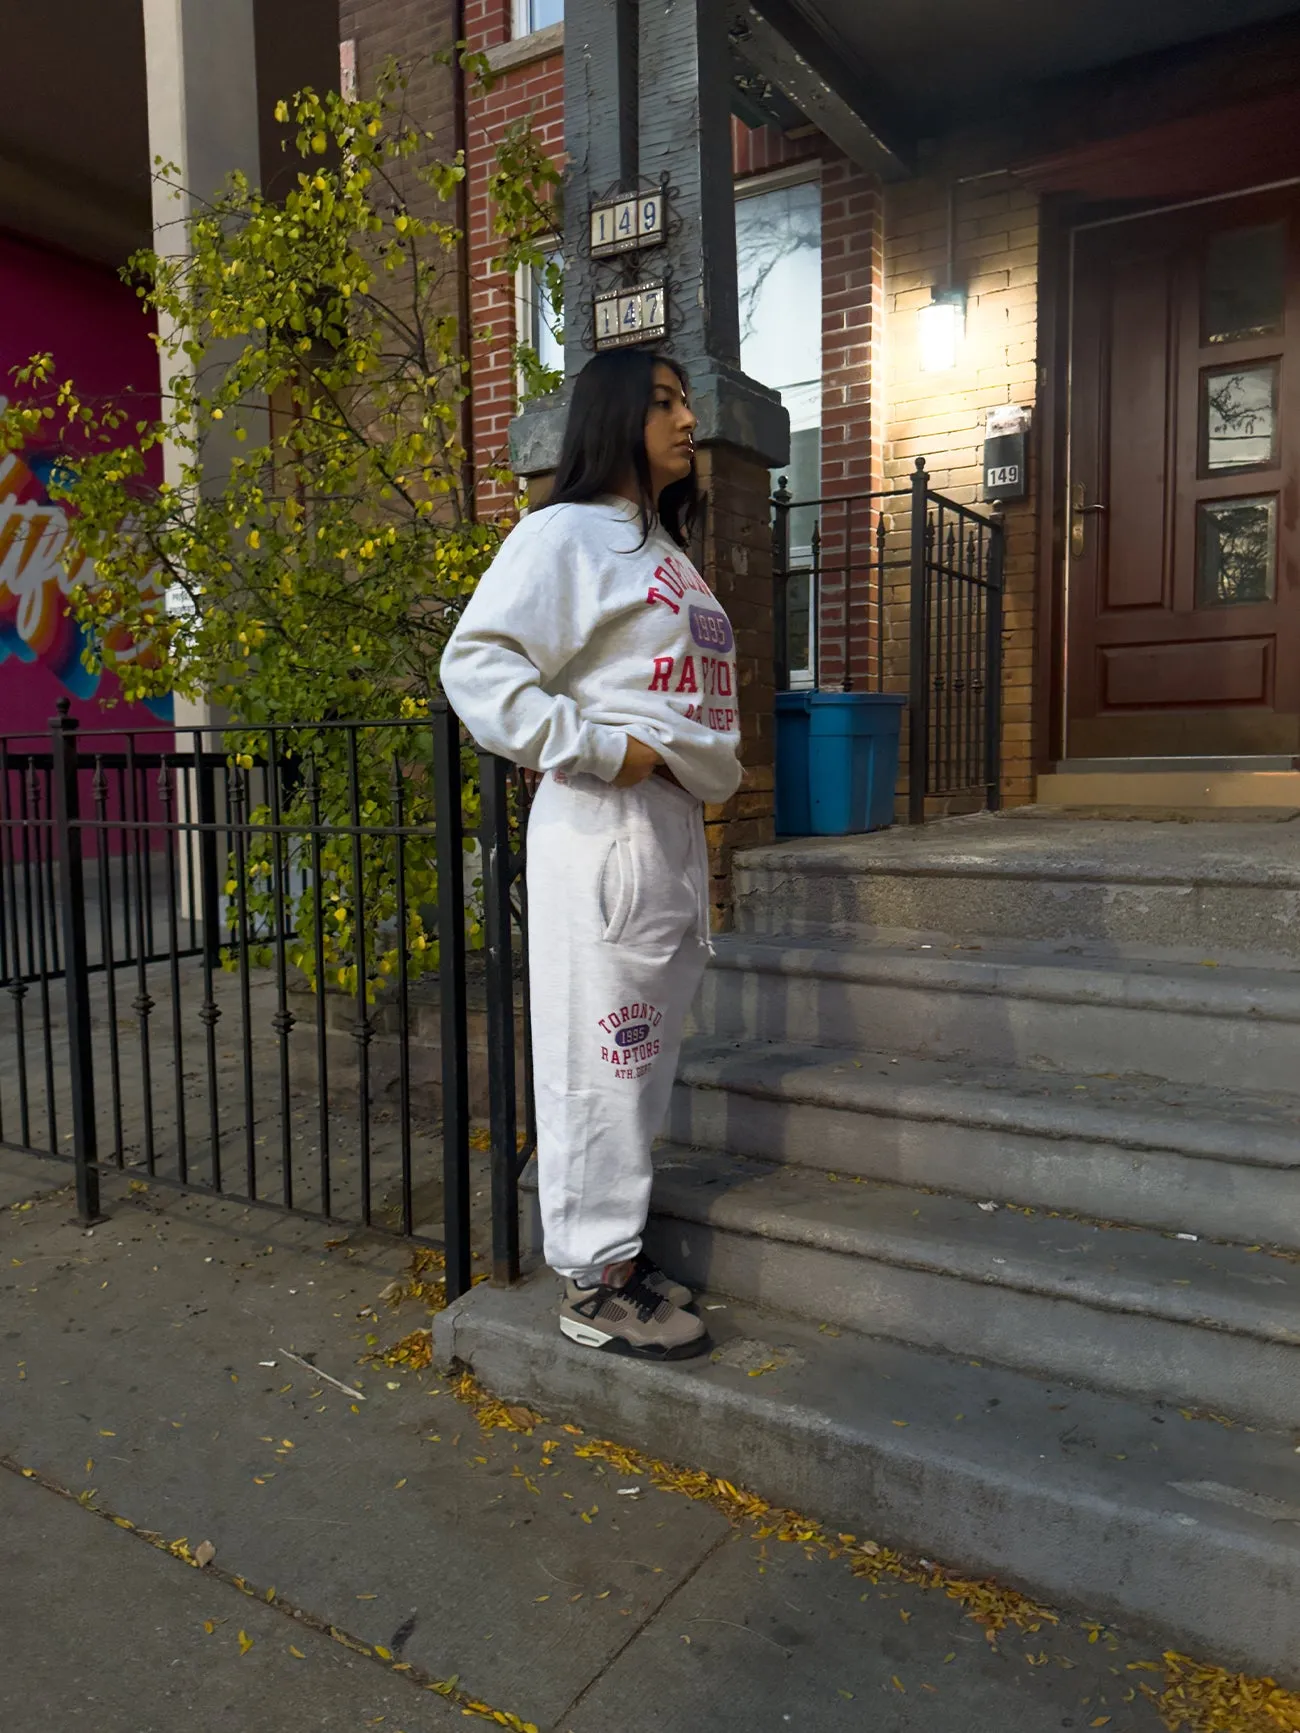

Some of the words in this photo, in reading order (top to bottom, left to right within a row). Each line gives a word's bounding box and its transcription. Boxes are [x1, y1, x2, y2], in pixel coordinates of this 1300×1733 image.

[599, 202, 656, 242] 149
[602, 292, 658, 334] 147
[990, 466, 1017, 484] 149
[694, 613, 726, 645] 1995
[648, 655, 737, 696] RAPTO
[598, 1002, 662, 1034] TORONTO
[621, 1027, 645, 1044] 1995
[601, 1039, 660, 1065] RAPTORS
